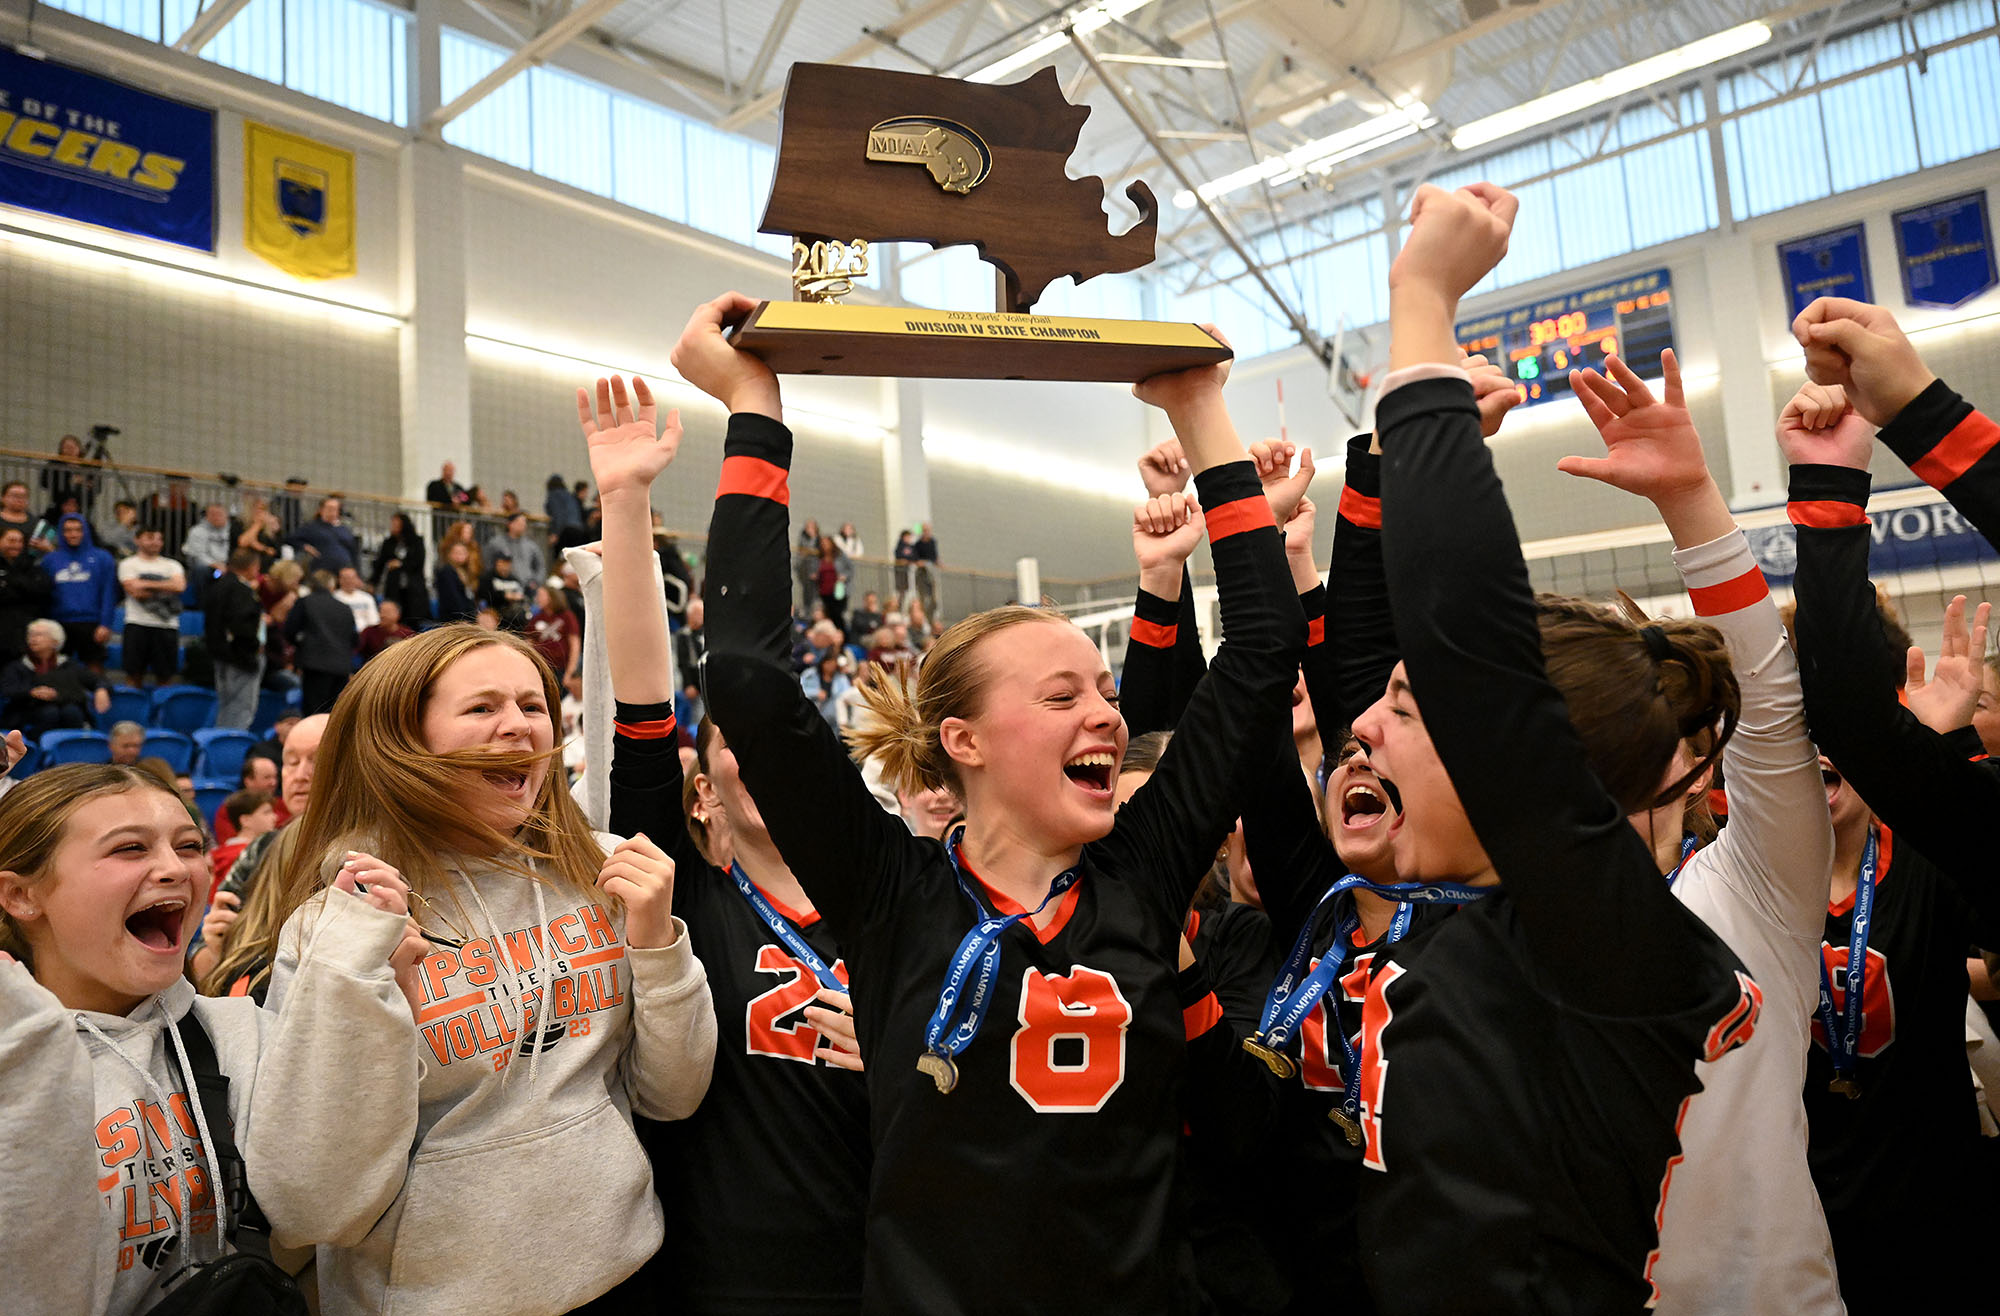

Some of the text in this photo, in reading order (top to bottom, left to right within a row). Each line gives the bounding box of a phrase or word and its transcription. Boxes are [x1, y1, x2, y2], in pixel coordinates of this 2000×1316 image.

[22, 98, 58, 119] OF
[66, 109, 121, 137] THE
[0, 110, 186, 191] CERS
[872, 136, 934, 157] MIAA
[792, 238, 869, 277] 2023
[904, 320, 1100, 340] DIVISION IV STATE CHAMPION
[947, 311, 973, 321] 2023
[1004, 314, 1051, 325] Volleyball
[951, 935, 982, 987] CHAMPION
[972, 956, 994, 1009] CHAMPION
[1283, 980, 1322, 1029] CHAMPION
[568, 1017, 591, 1038] 23
[1009, 964, 1133, 1113] 8
